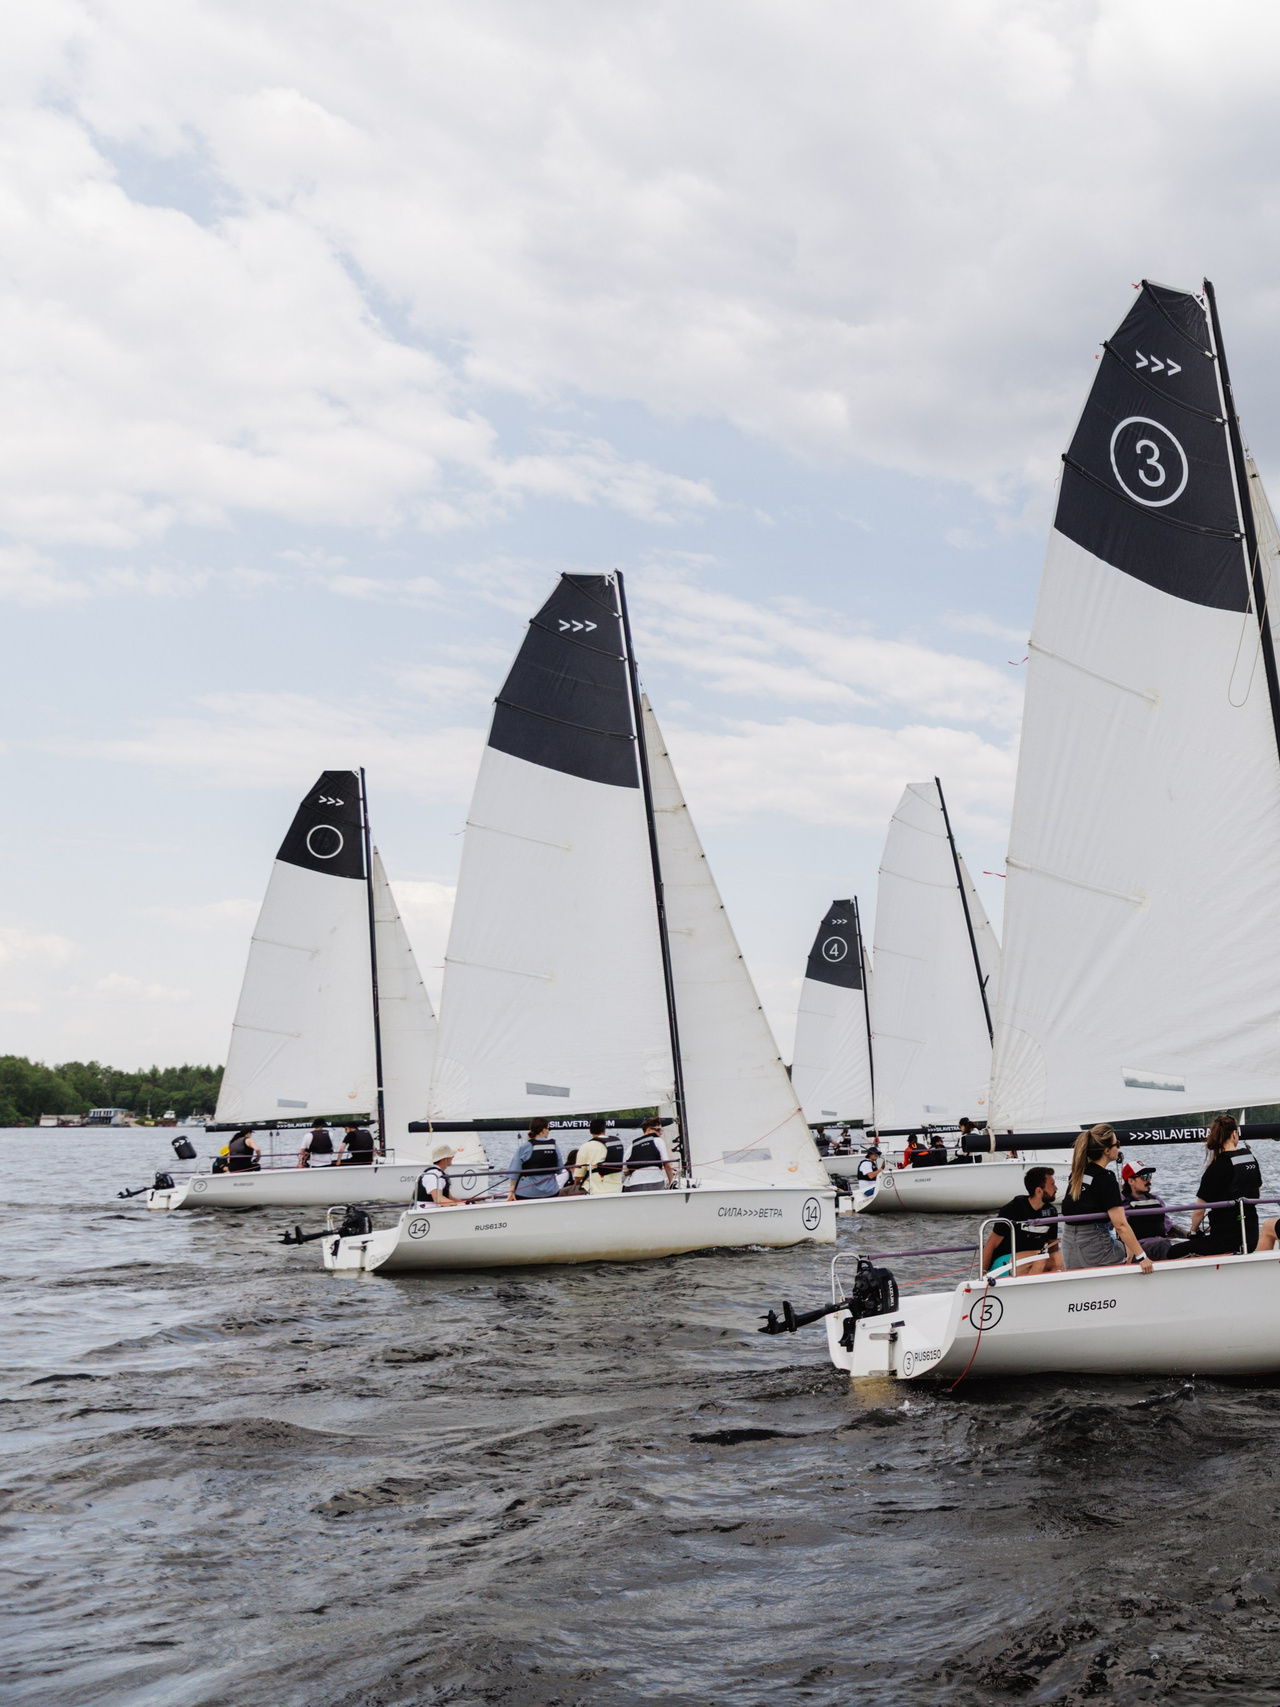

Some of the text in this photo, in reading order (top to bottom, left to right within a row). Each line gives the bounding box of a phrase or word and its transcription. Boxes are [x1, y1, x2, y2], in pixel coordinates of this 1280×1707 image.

[1135, 439, 1166, 488] 3
[474, 1222, 508, 1231] RUS6130
[887, 1280, 895, 1307] SUZUKI
[1067, 1299, 1117, 1313] RUS6150
[914, 1349, 942, 1362] RUS6150
